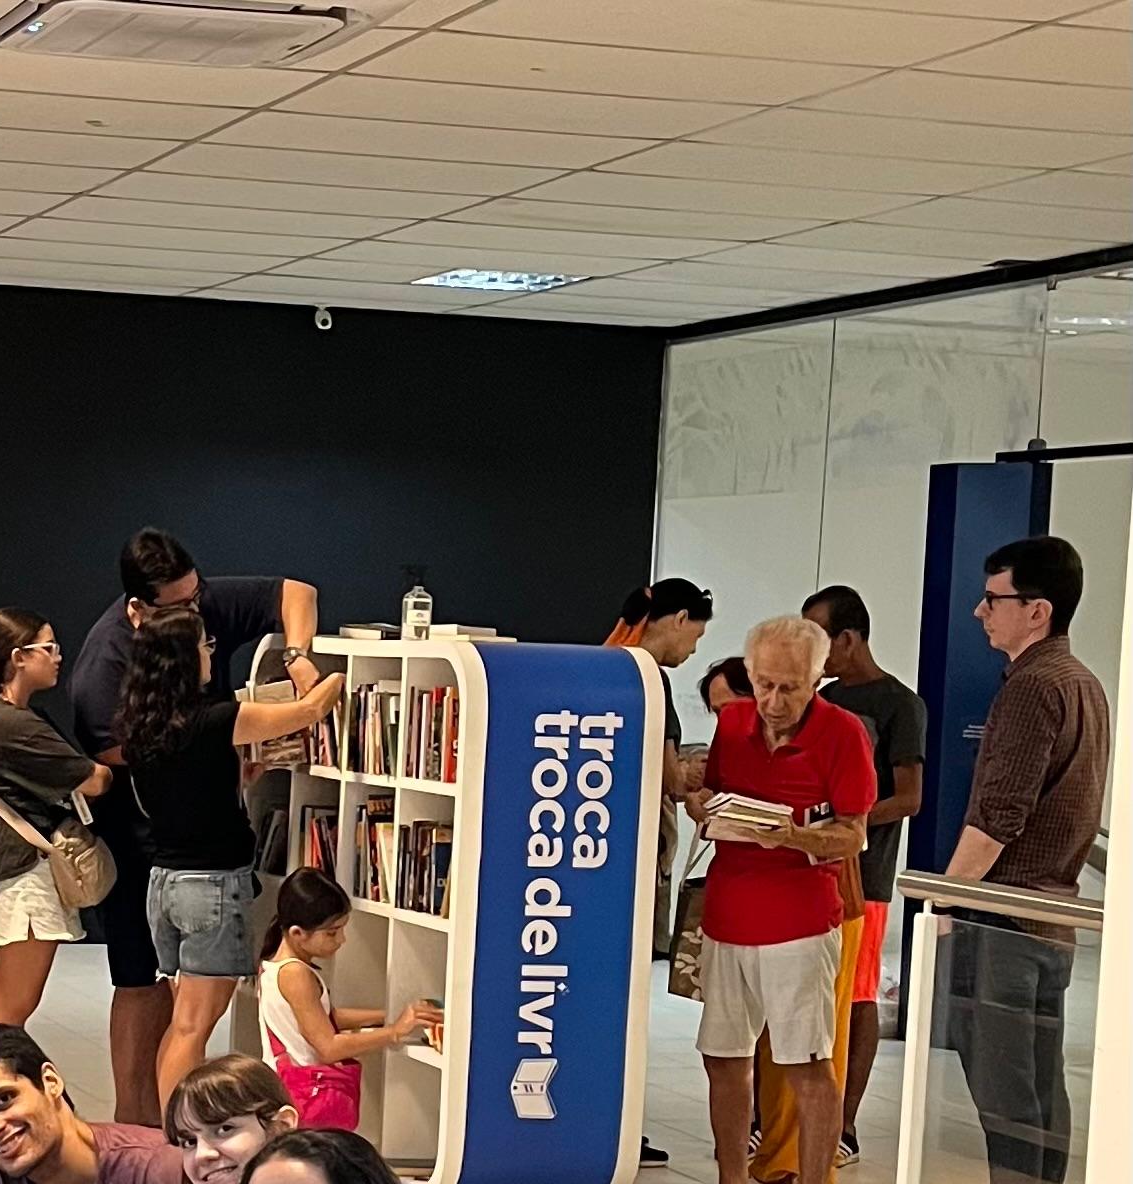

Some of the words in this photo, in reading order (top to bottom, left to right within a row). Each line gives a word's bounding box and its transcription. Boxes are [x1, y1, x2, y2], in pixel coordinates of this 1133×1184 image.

[526, 709, 578, 868] troca
[572, 711, 624, 869] troca
[521, 877, 572, 956] de
